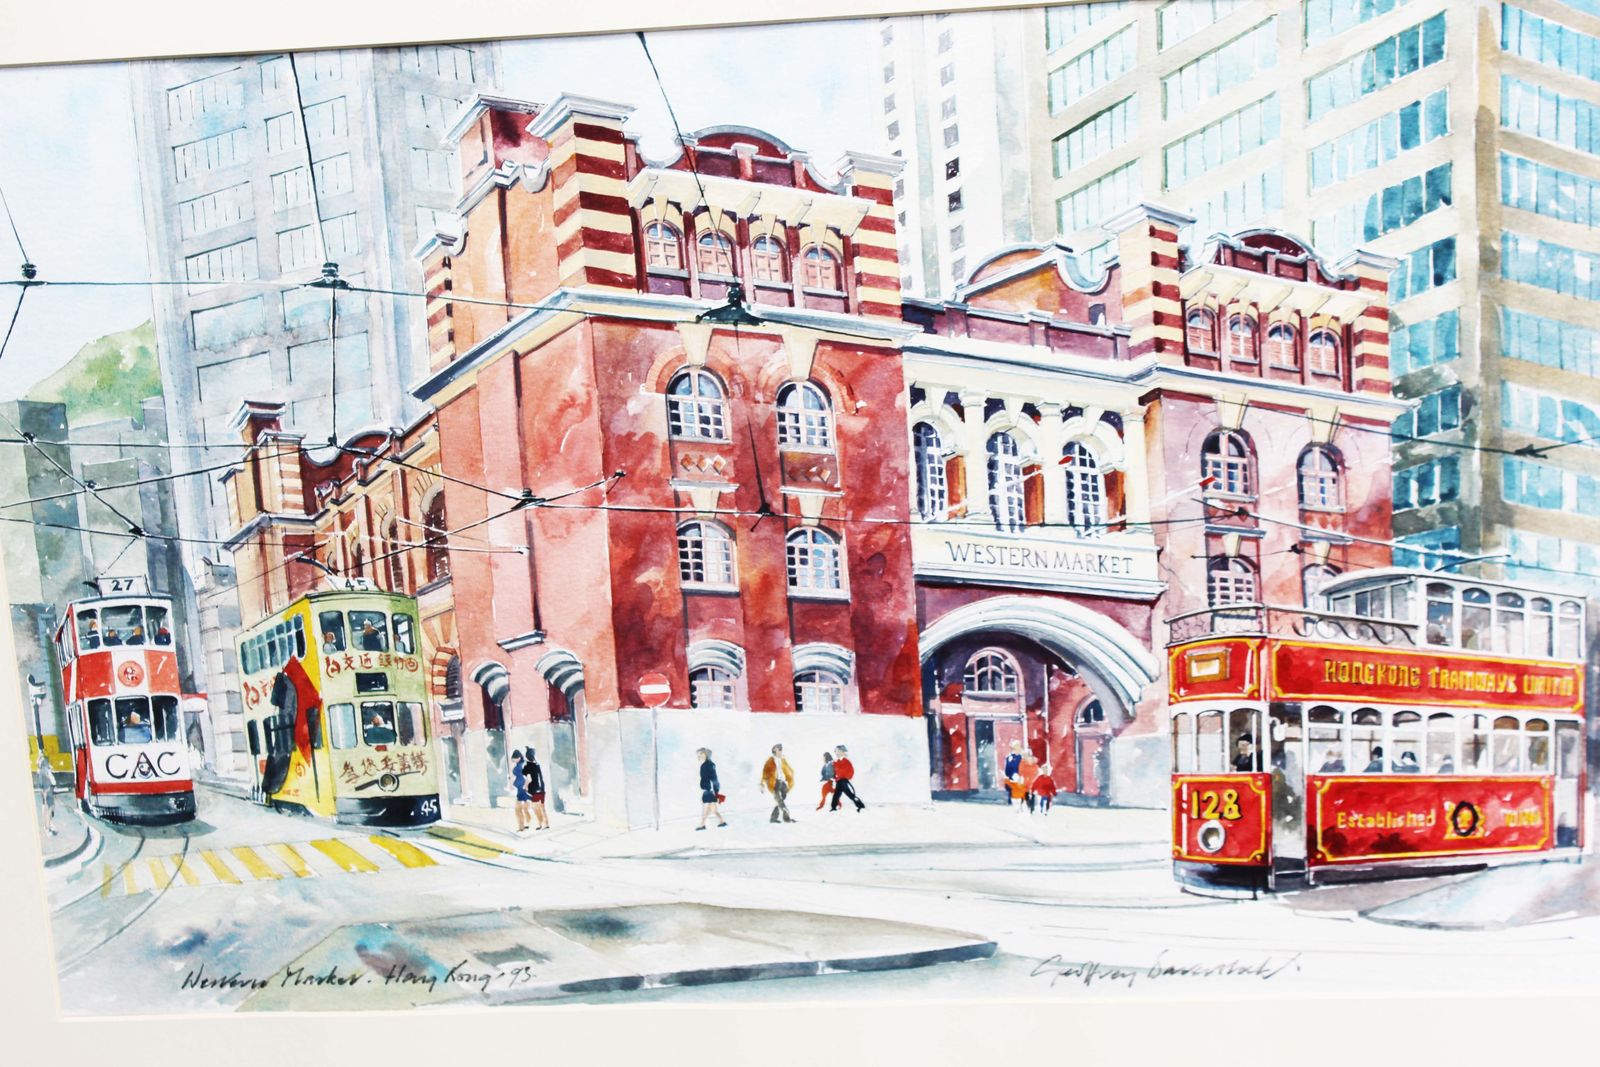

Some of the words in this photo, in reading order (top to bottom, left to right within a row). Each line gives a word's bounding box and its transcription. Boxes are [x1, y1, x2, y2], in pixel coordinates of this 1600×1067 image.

[945, 541, 1048, 569] WESTERN
[1053, 551, 1133, 575] MARKET
[111, 579, 133, 592] 27
[345, 579, 369, 592] 45
[1428, 666, 1518, 693] TRAMWAYS
[105, 751, 180, 780] CAC
[420, 799, 438, 817] 45
[1191, 789, 1243, 820] 128
[1337, 808, 1436, 829] Established
[181, 963, 268, 989] Western
[385, 964, 437, 992] Hong
[444, 959, 492, 992] Kong
